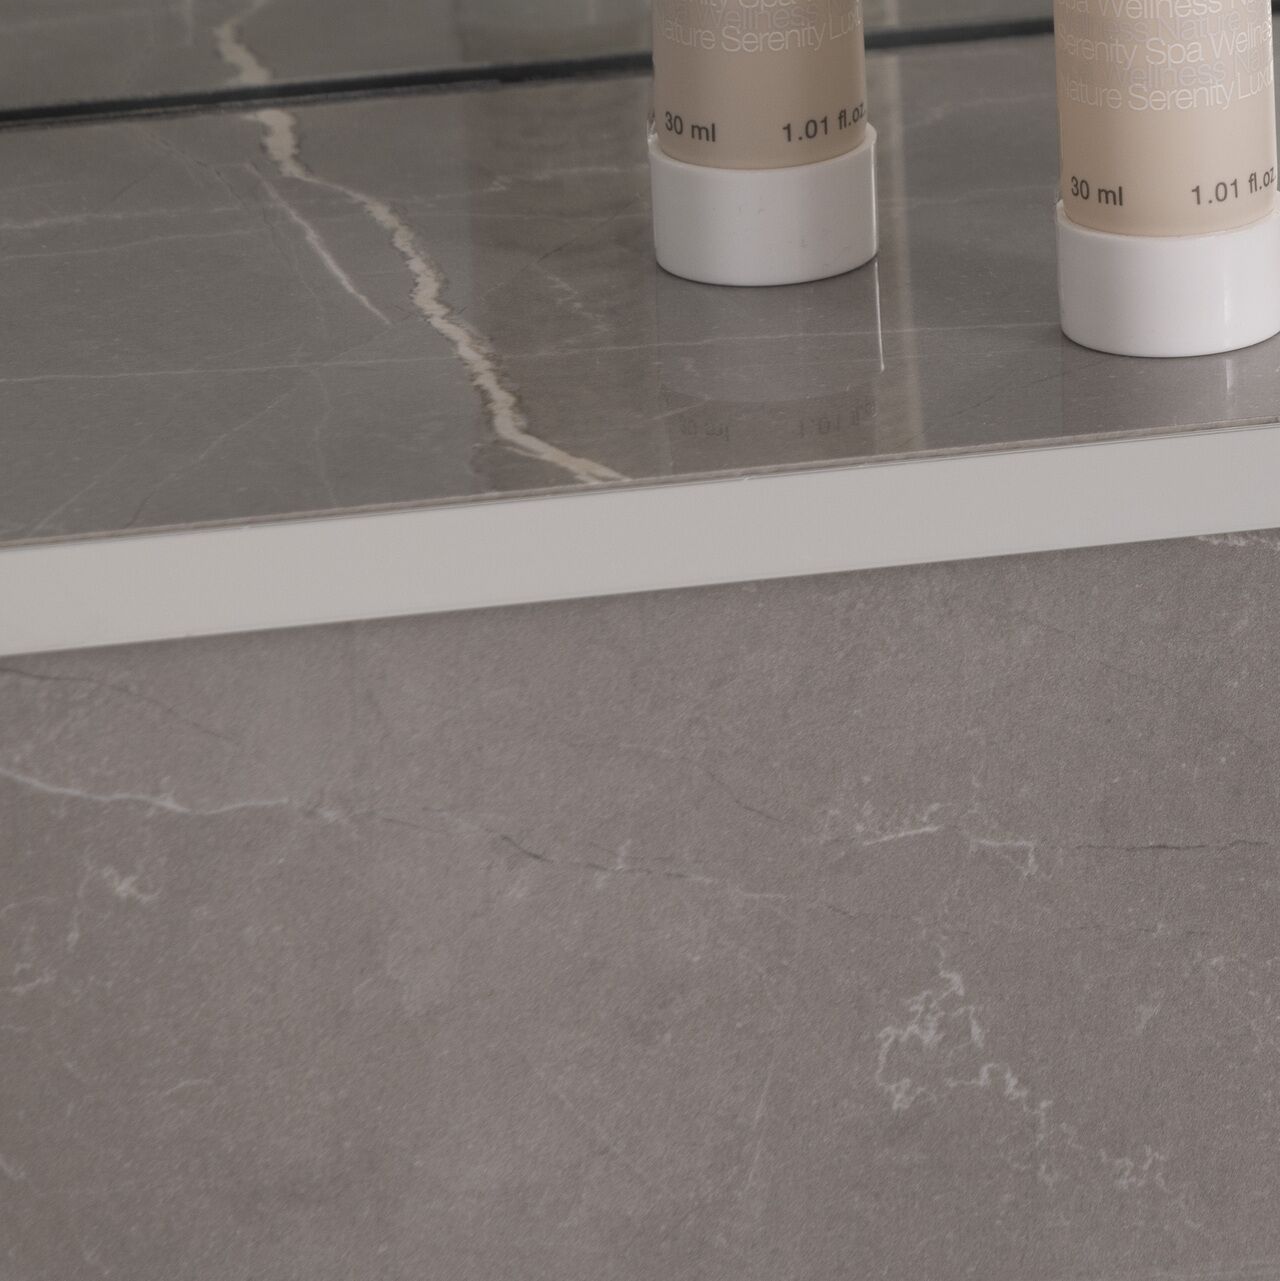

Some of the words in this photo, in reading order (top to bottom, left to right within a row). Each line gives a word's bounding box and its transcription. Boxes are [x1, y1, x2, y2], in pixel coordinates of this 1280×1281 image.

[721, 23, 826, 53] Serenity
[1145, 37, 1205, 70] Spa
[1128, 80, 1235, 111] Serenity
[664, 111, 684, 135] 30
[690, 123, 717, 143] ml
[782, 116, 829, 143] 1.01
[1071, 176, 1089, 200] 30
[1097, 186, 1123, 206] ml
[1191, 178, 1238, 205] 1.01
